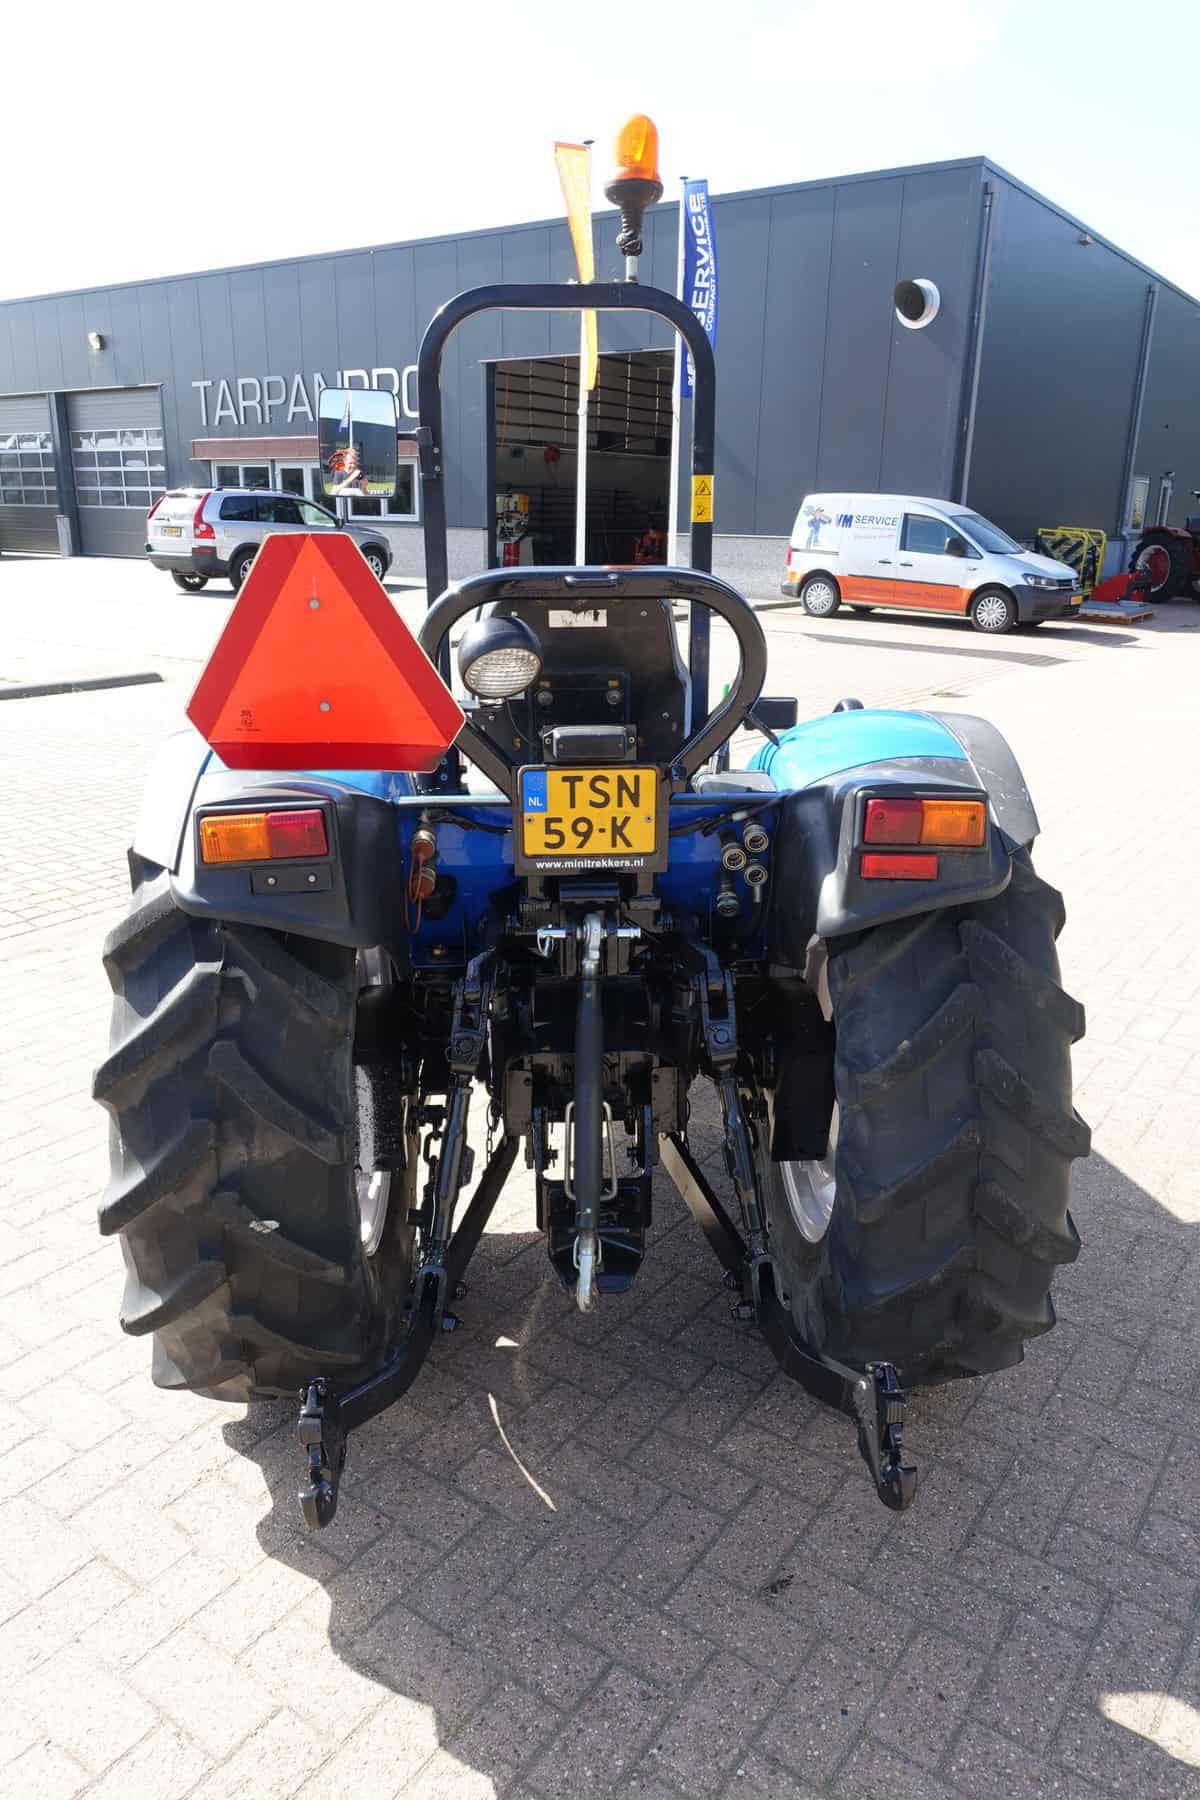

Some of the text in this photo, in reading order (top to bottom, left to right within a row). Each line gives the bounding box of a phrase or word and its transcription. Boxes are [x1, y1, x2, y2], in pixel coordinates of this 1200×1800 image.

[705, 277, 717, 331] COMPACT
[836, 514, 899, 528] VM SERVICE
[528, 797, 543, 807] NL
[561, 775, 640, 808] TSN
[544, 816, 633, 849] 59-K
[536, 859, 644, 869] www.minitrekkers.nl
